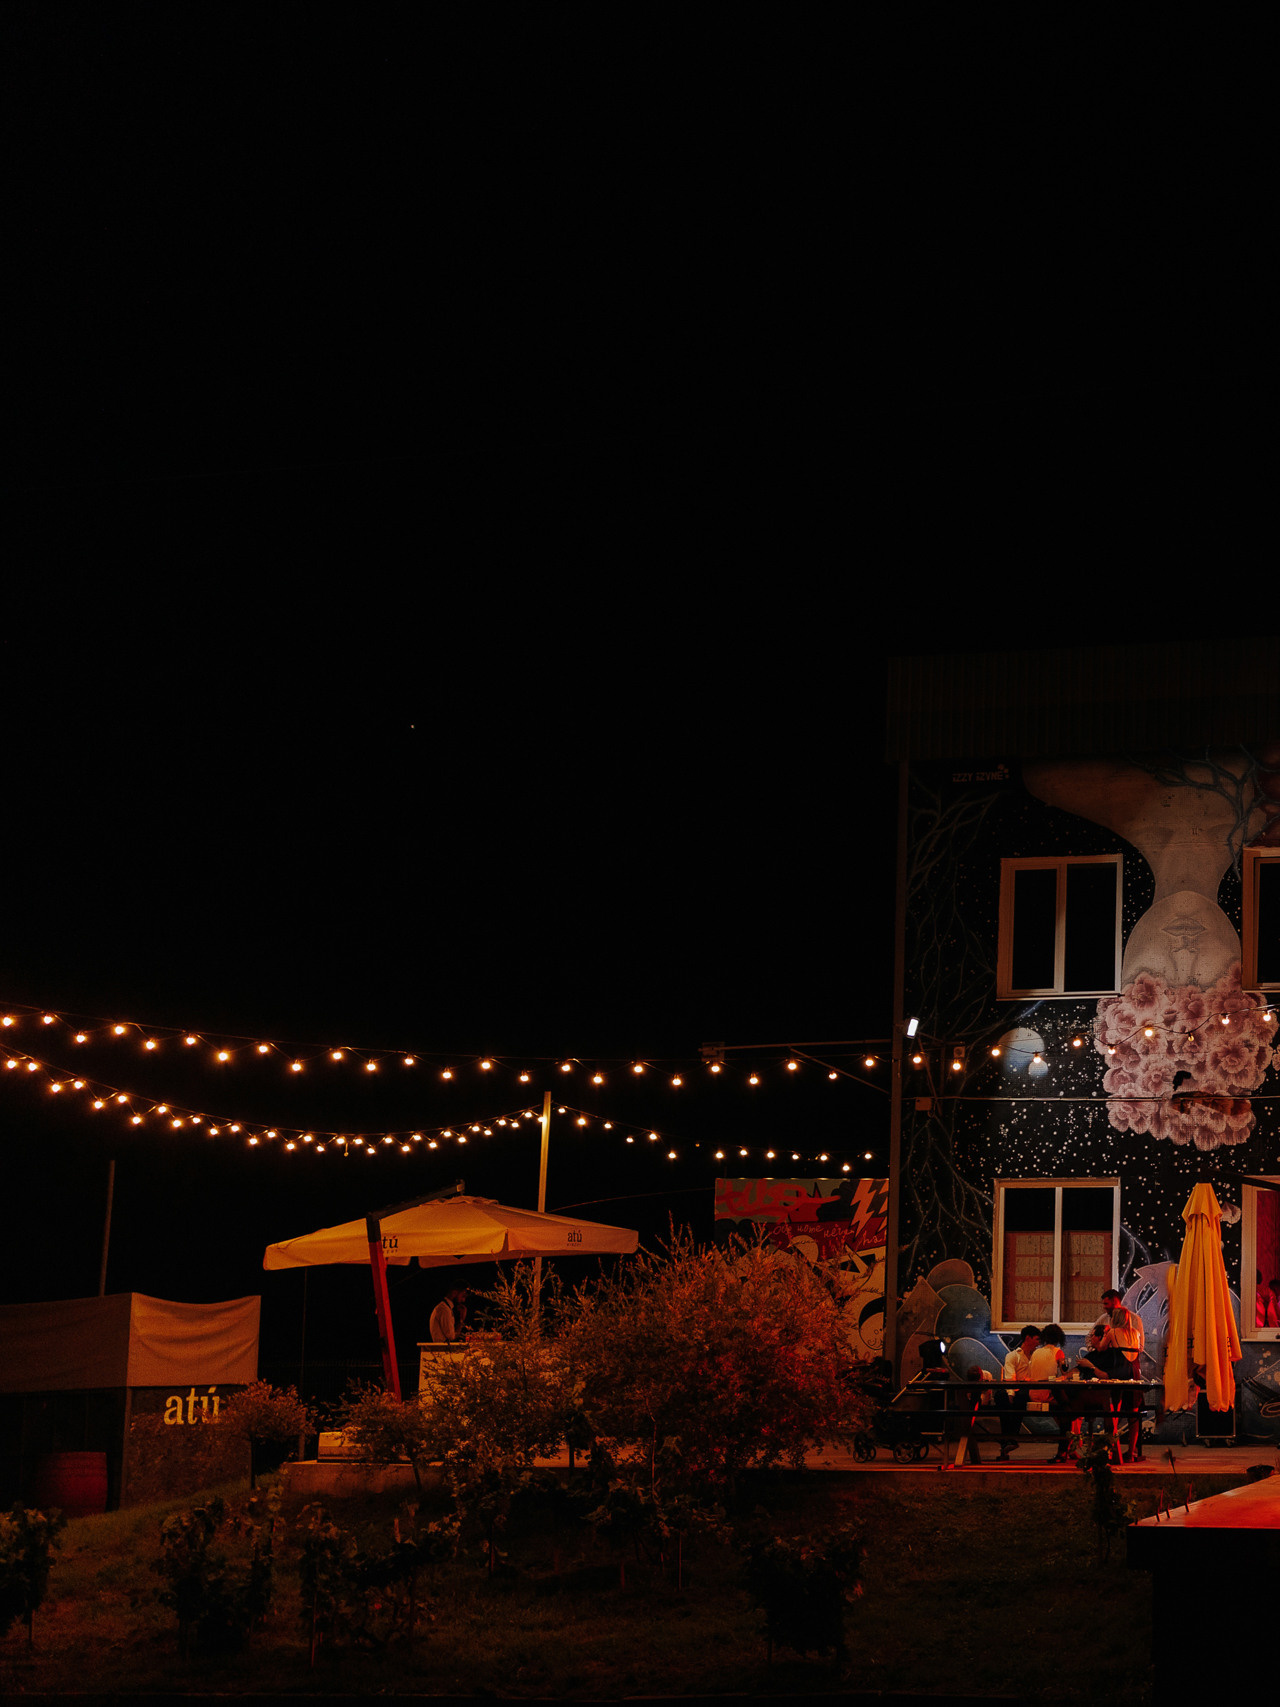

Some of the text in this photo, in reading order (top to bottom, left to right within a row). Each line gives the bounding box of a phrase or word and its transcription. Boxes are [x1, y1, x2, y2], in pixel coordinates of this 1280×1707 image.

[381, 1235, 399, 1249] tú
[567, 1229, 583, 1242] atú
[163, 1386, 220, 1425] atú
